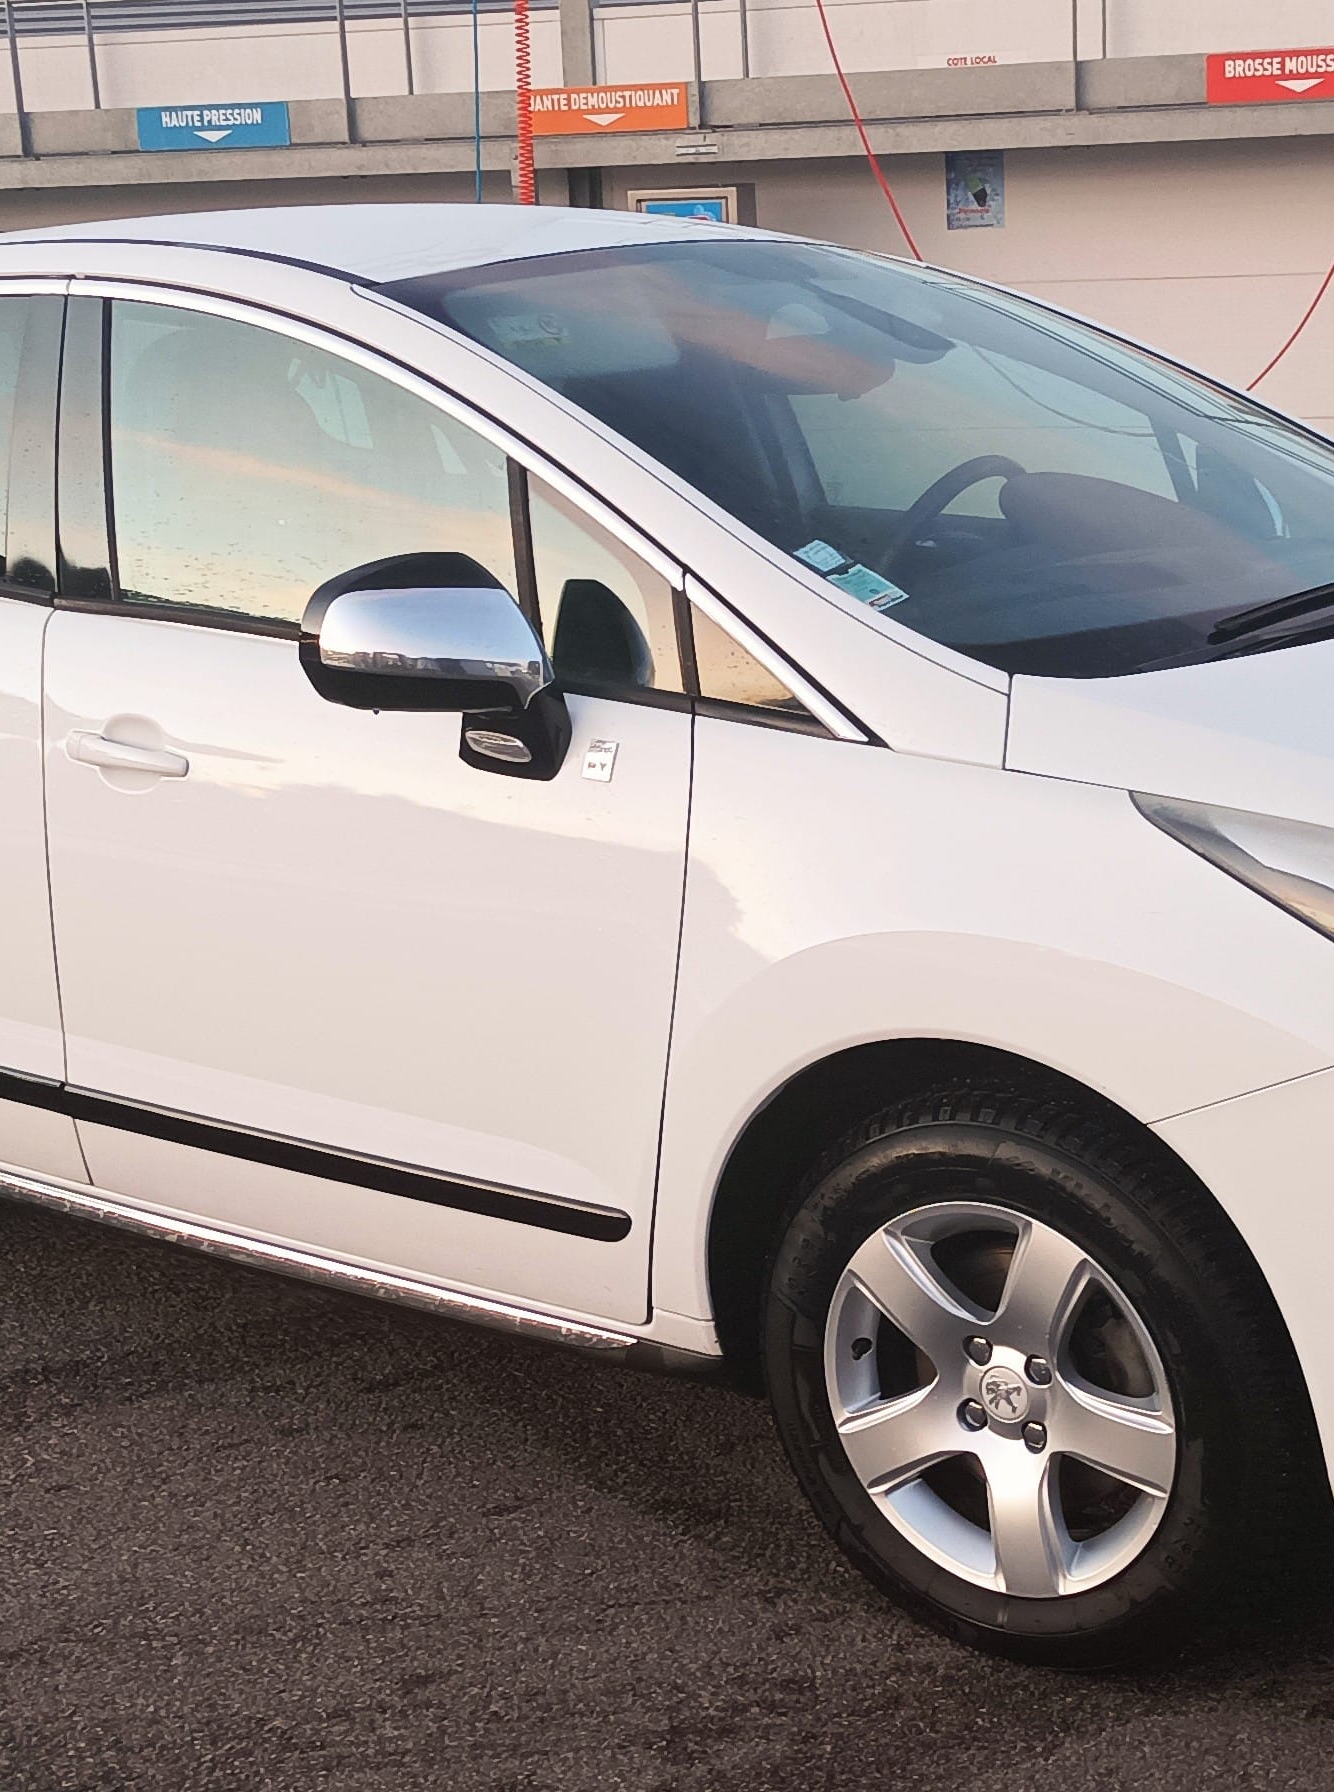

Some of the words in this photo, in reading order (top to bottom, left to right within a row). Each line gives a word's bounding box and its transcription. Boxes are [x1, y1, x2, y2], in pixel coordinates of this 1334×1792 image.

[970, 55, 997, 65] LOCAL
[1224, 57, 1282, 78] BROSSE
[570, 89, 680, 110] DEMOUSTIQUANT
[161, 110, 202, 128] HAUTE
[203, 108, 262, 126] PRESSION
